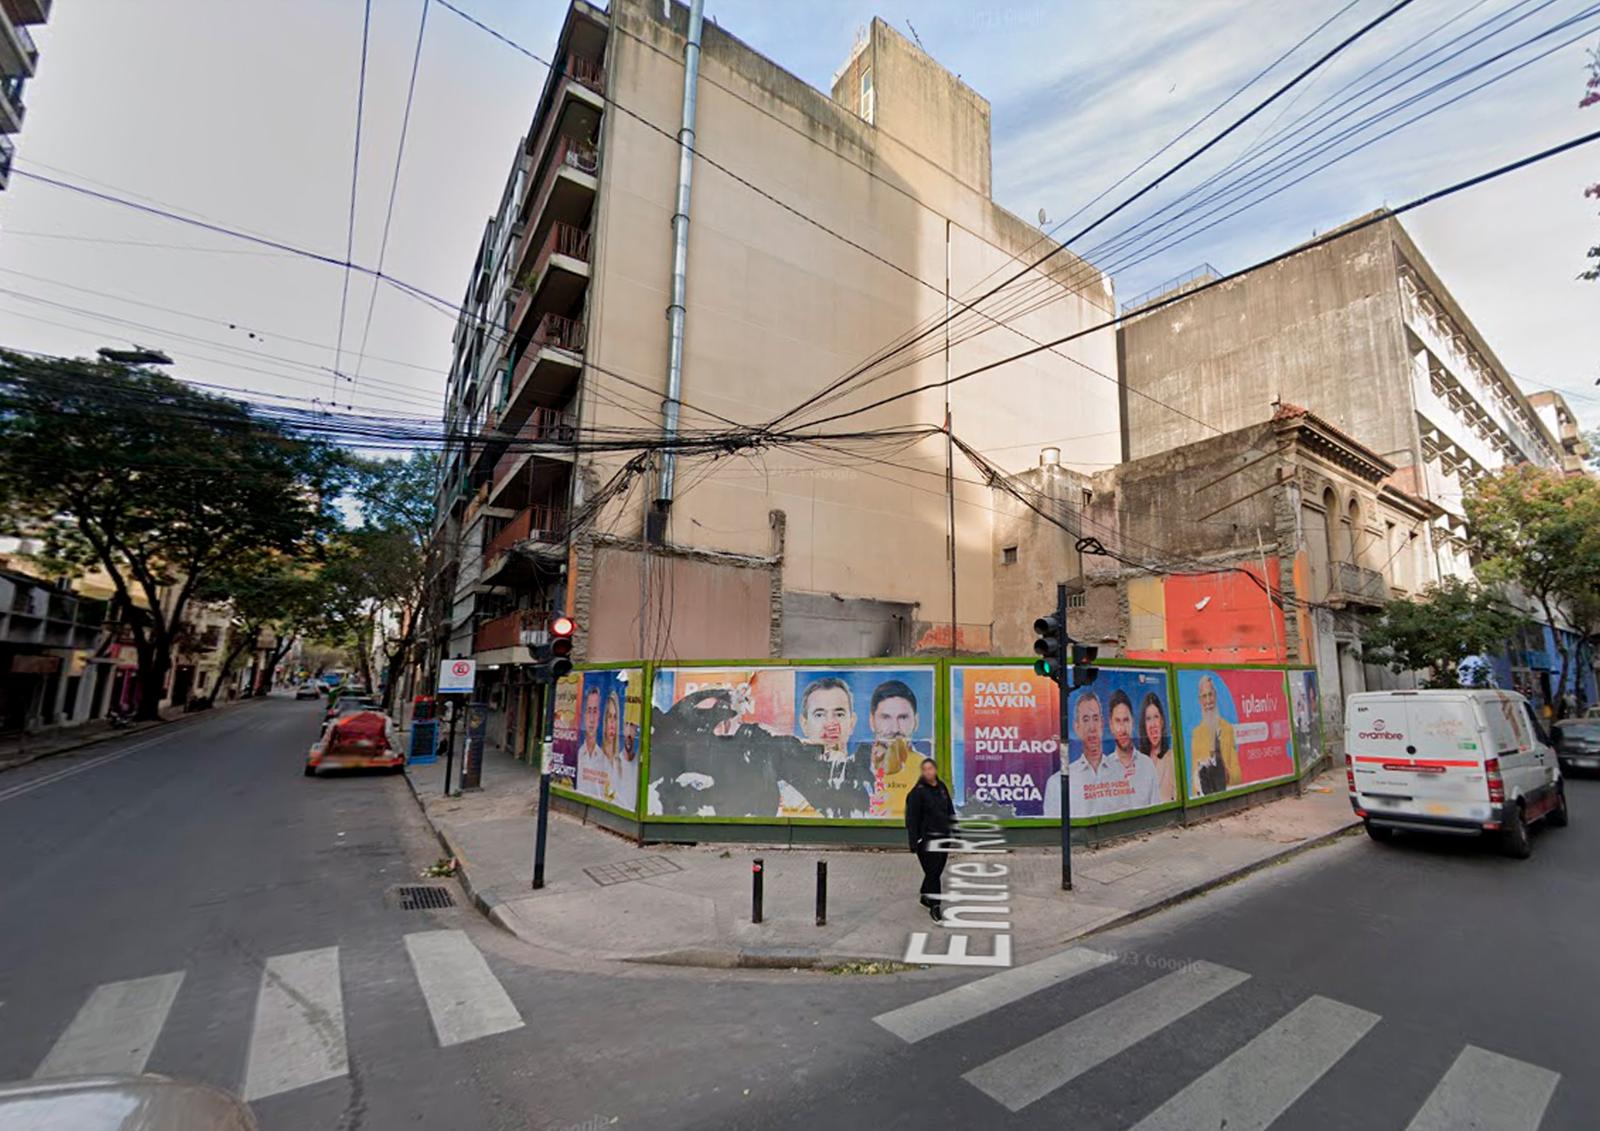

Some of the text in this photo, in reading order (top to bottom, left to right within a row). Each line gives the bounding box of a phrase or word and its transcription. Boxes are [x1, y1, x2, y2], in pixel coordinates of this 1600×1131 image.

[974, 682, 1033, 695] PABLO
[974, 695, 1036, 708] JAVKIN
[974, 726, 1019, 739] MAXI
[975, 740, 1058, 754] PULLARO
[975, 773, 1035, 787] CLARA
